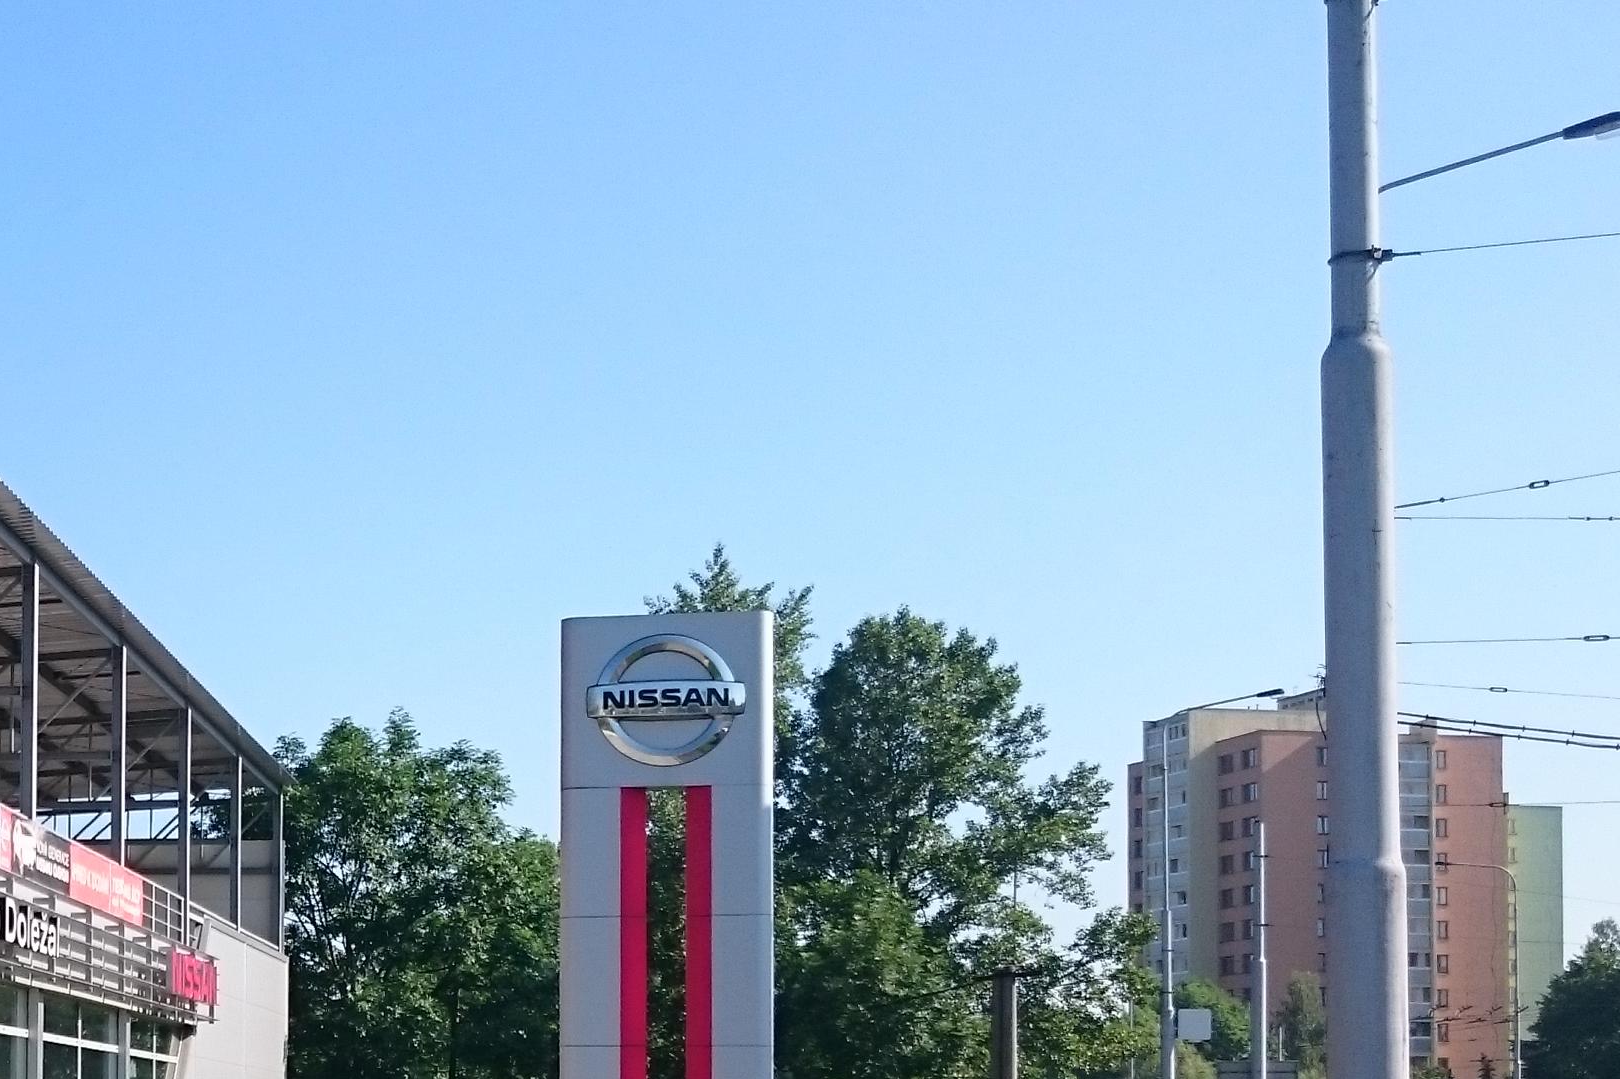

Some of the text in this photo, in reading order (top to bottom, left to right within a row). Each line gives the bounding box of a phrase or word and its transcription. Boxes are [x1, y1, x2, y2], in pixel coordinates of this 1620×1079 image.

[602, 687, 730, 710] NISSAN
[4, 896, 60, 958] Doležal
[171, 949, 218, 1006] NISSAN
